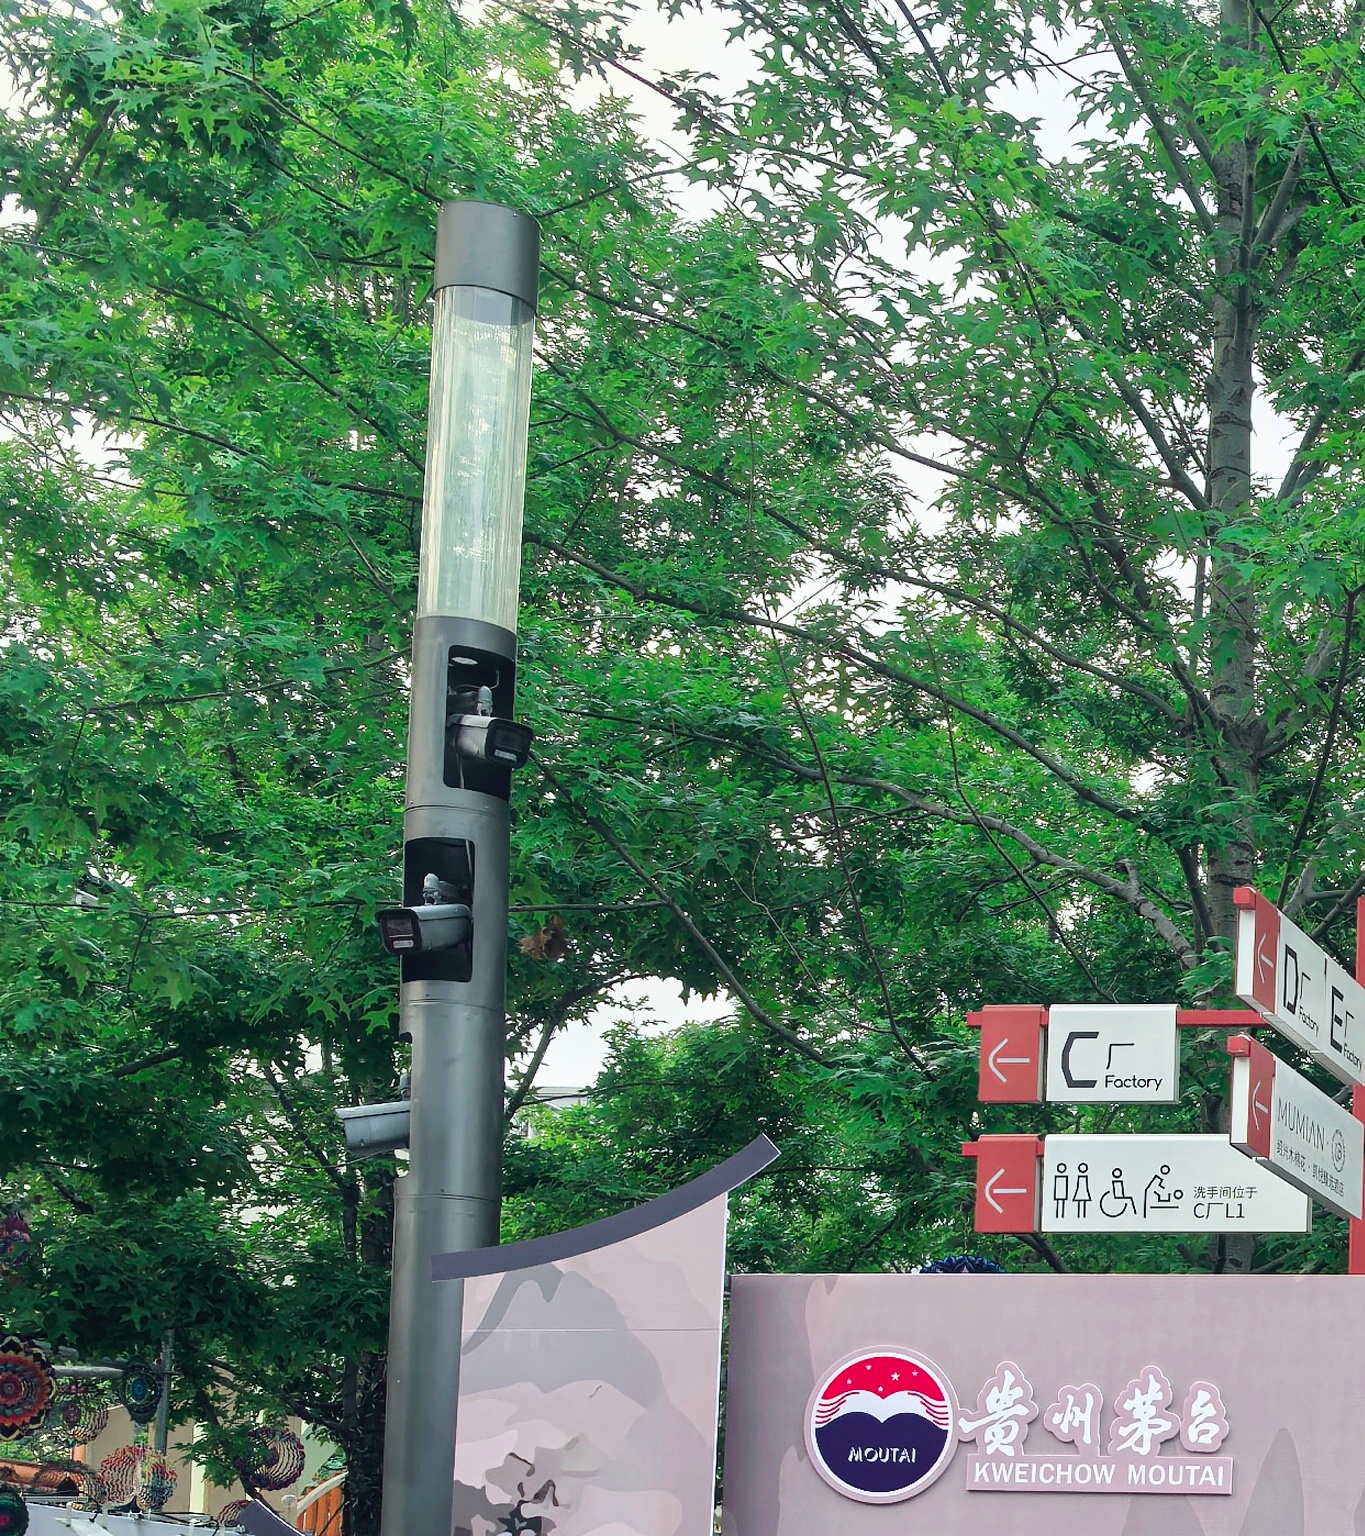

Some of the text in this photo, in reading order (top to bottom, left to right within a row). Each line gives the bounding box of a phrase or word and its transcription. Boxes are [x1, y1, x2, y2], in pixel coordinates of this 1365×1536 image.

[1299, 1005, 1319, 1038] Factory
[1343, 1042, 1364, 1073] Factory
[1104, 1075, 1163, 1091] Factory
[1193, 1186, 1258, 1200] 洗手间位于
[847, 1446, 917, 1464] MOUTAI
[974, 1461, 1224, 1487] KWEICHOW MOUTAI
